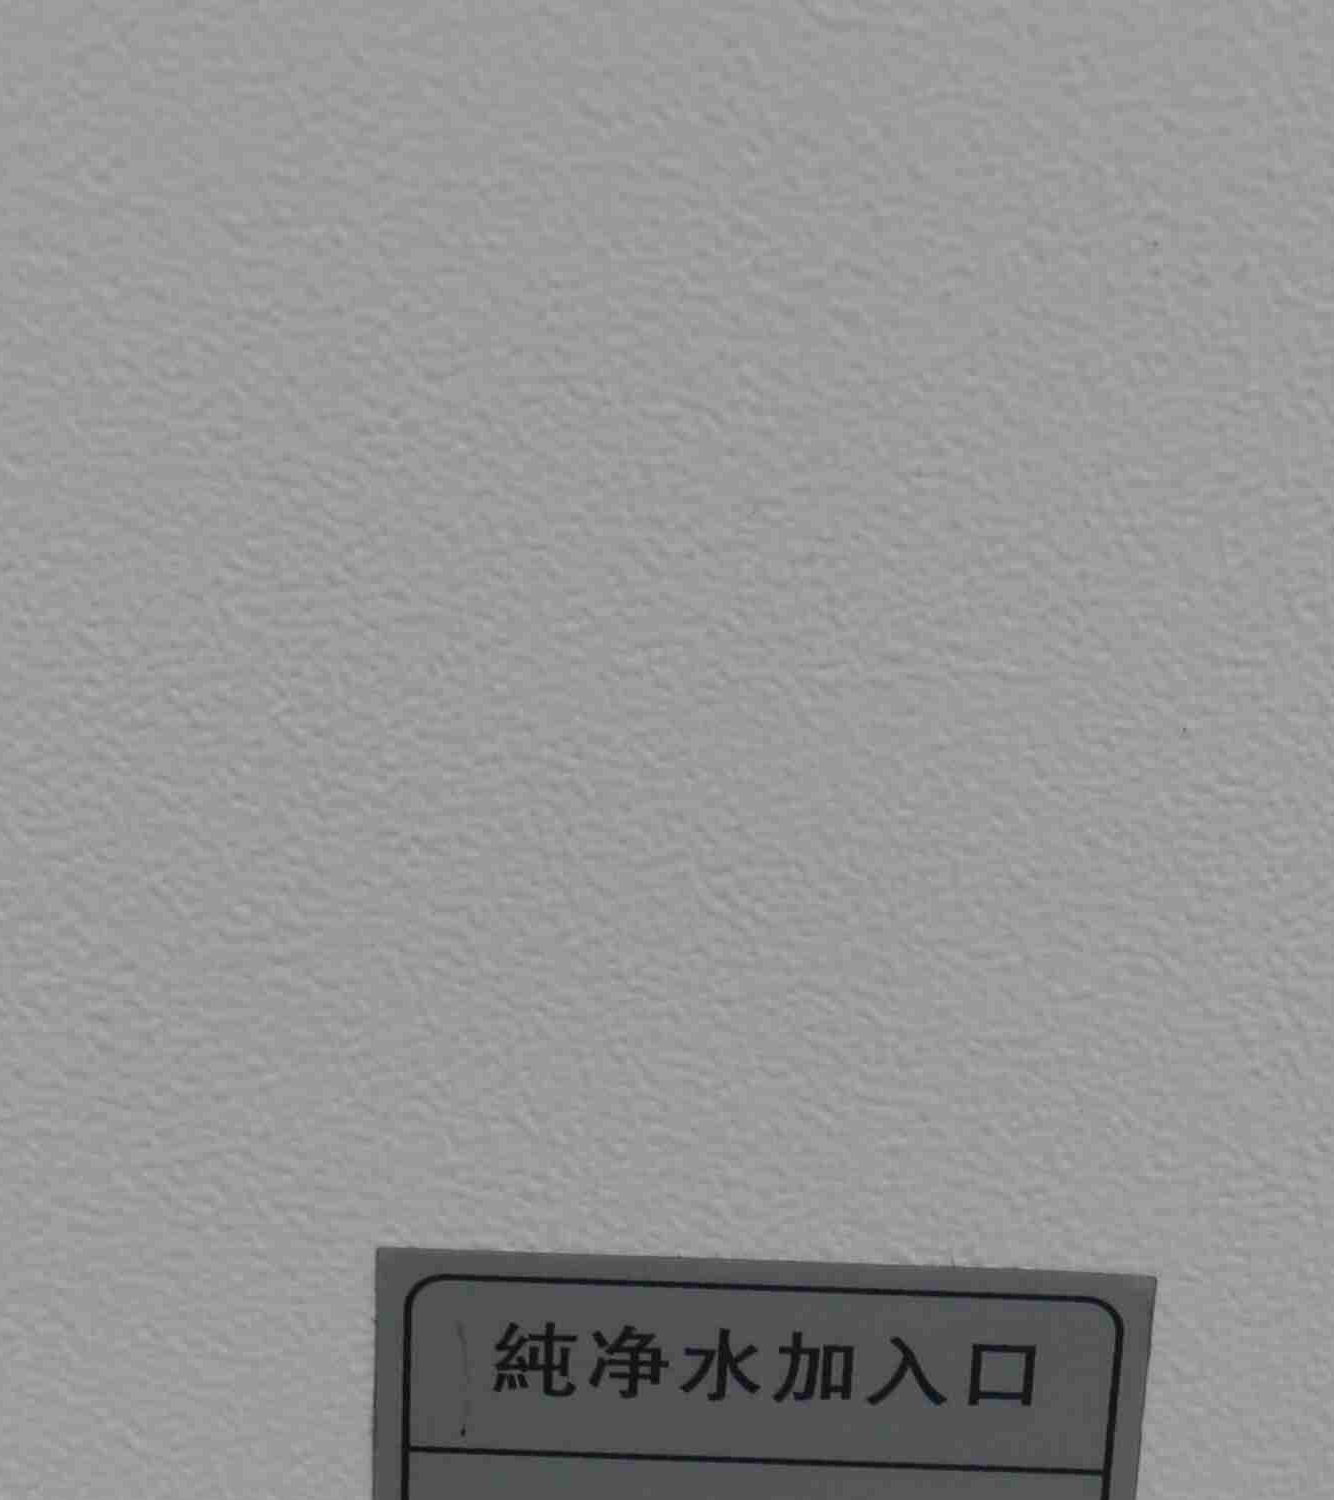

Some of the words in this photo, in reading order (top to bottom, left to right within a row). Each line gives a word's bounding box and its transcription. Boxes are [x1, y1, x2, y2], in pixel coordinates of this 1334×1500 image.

[492, 1321, 1037, 1407] 純净水加入口
